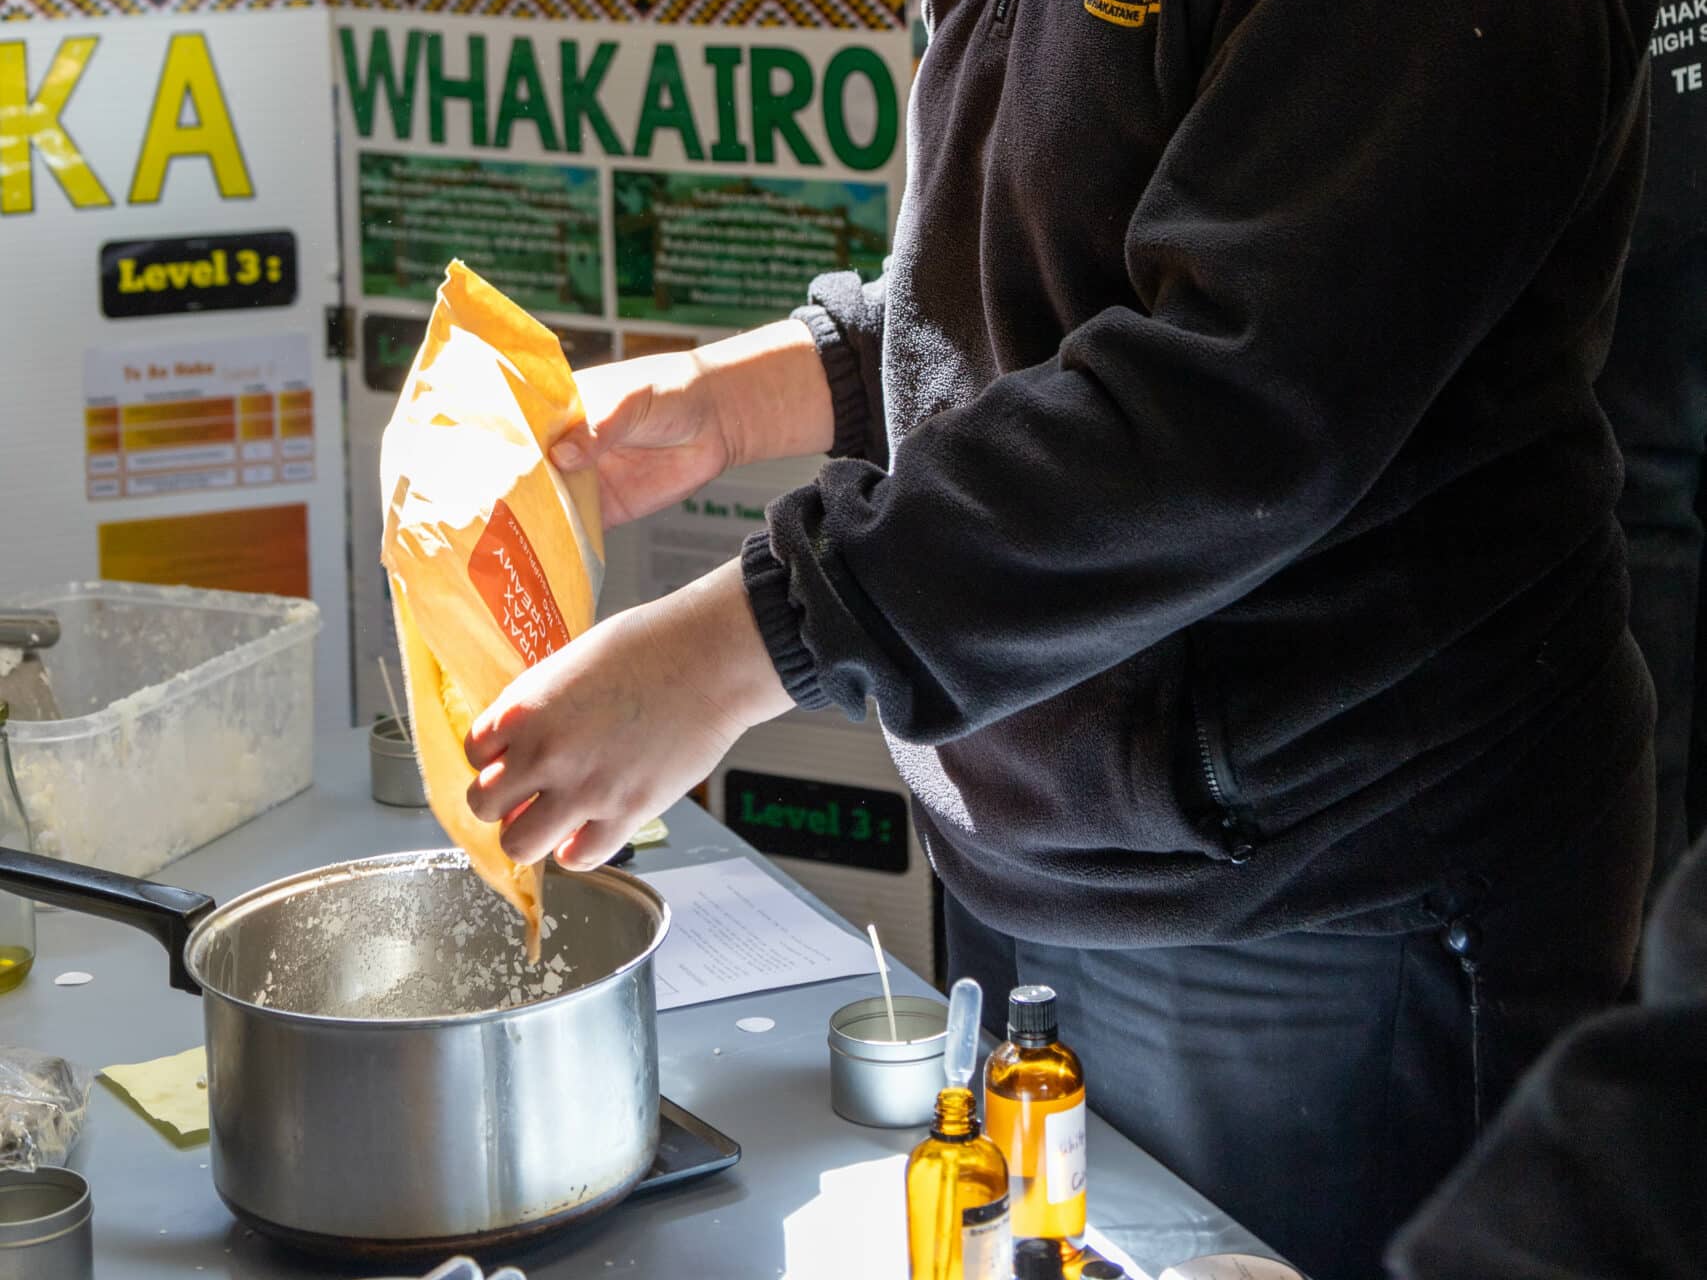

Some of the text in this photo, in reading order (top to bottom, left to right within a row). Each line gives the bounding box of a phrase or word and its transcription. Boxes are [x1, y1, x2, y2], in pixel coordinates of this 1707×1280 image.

[338, 26, 899, 171] WHAKAIRO
[117, 249, 229, 293] Level
[492, 547, 545, 638] CREAMY
[504, 606, 537, 664] URAL
[740, 790, 841, 837] Level
